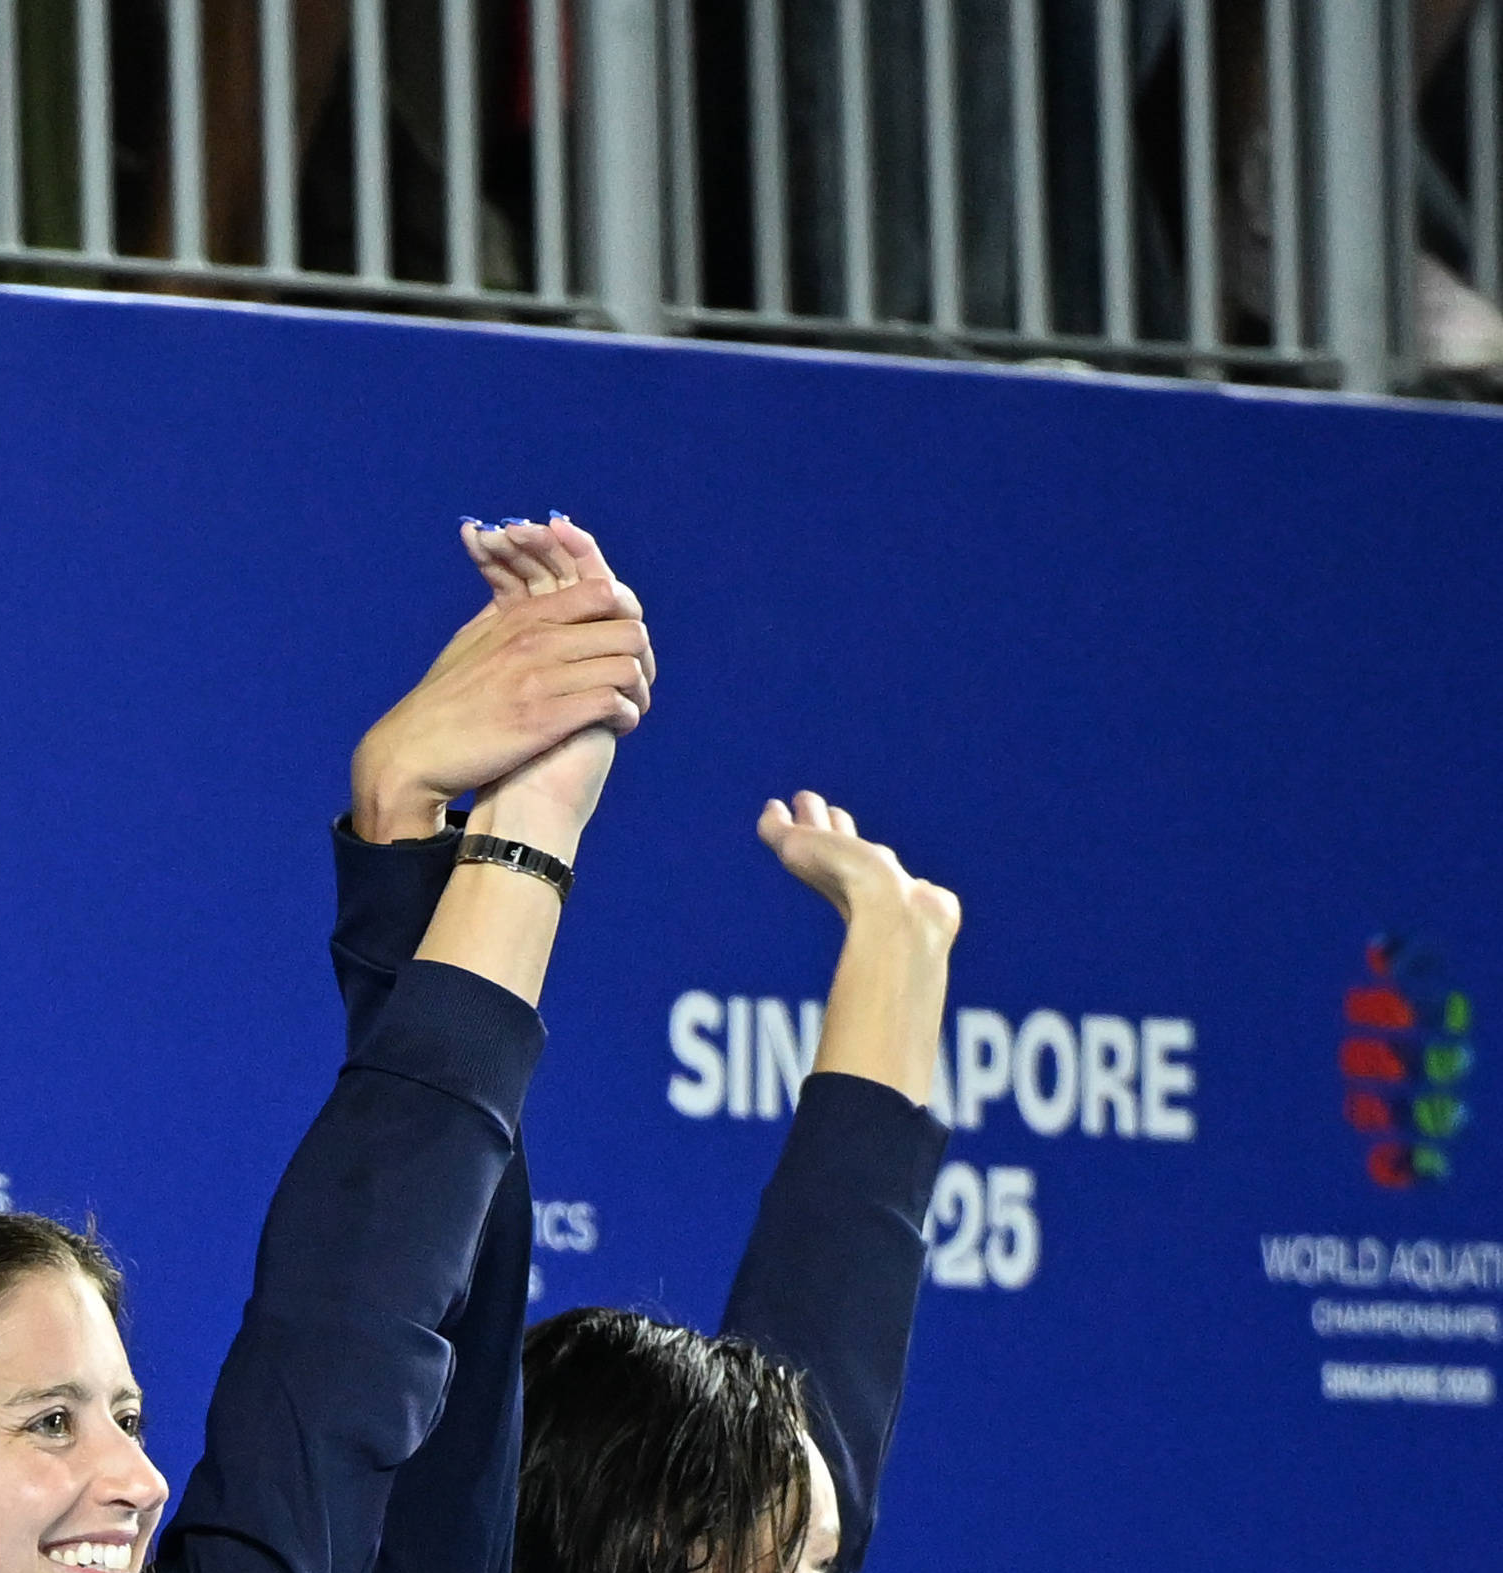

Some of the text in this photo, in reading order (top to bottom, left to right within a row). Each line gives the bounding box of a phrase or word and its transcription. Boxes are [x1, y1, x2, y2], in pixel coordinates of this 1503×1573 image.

[668, 990, 1195, 1142] SINPORE
[925, 1162, 1039, 1289] 25
[1261, 1234, 1387, 1287] WORLD
